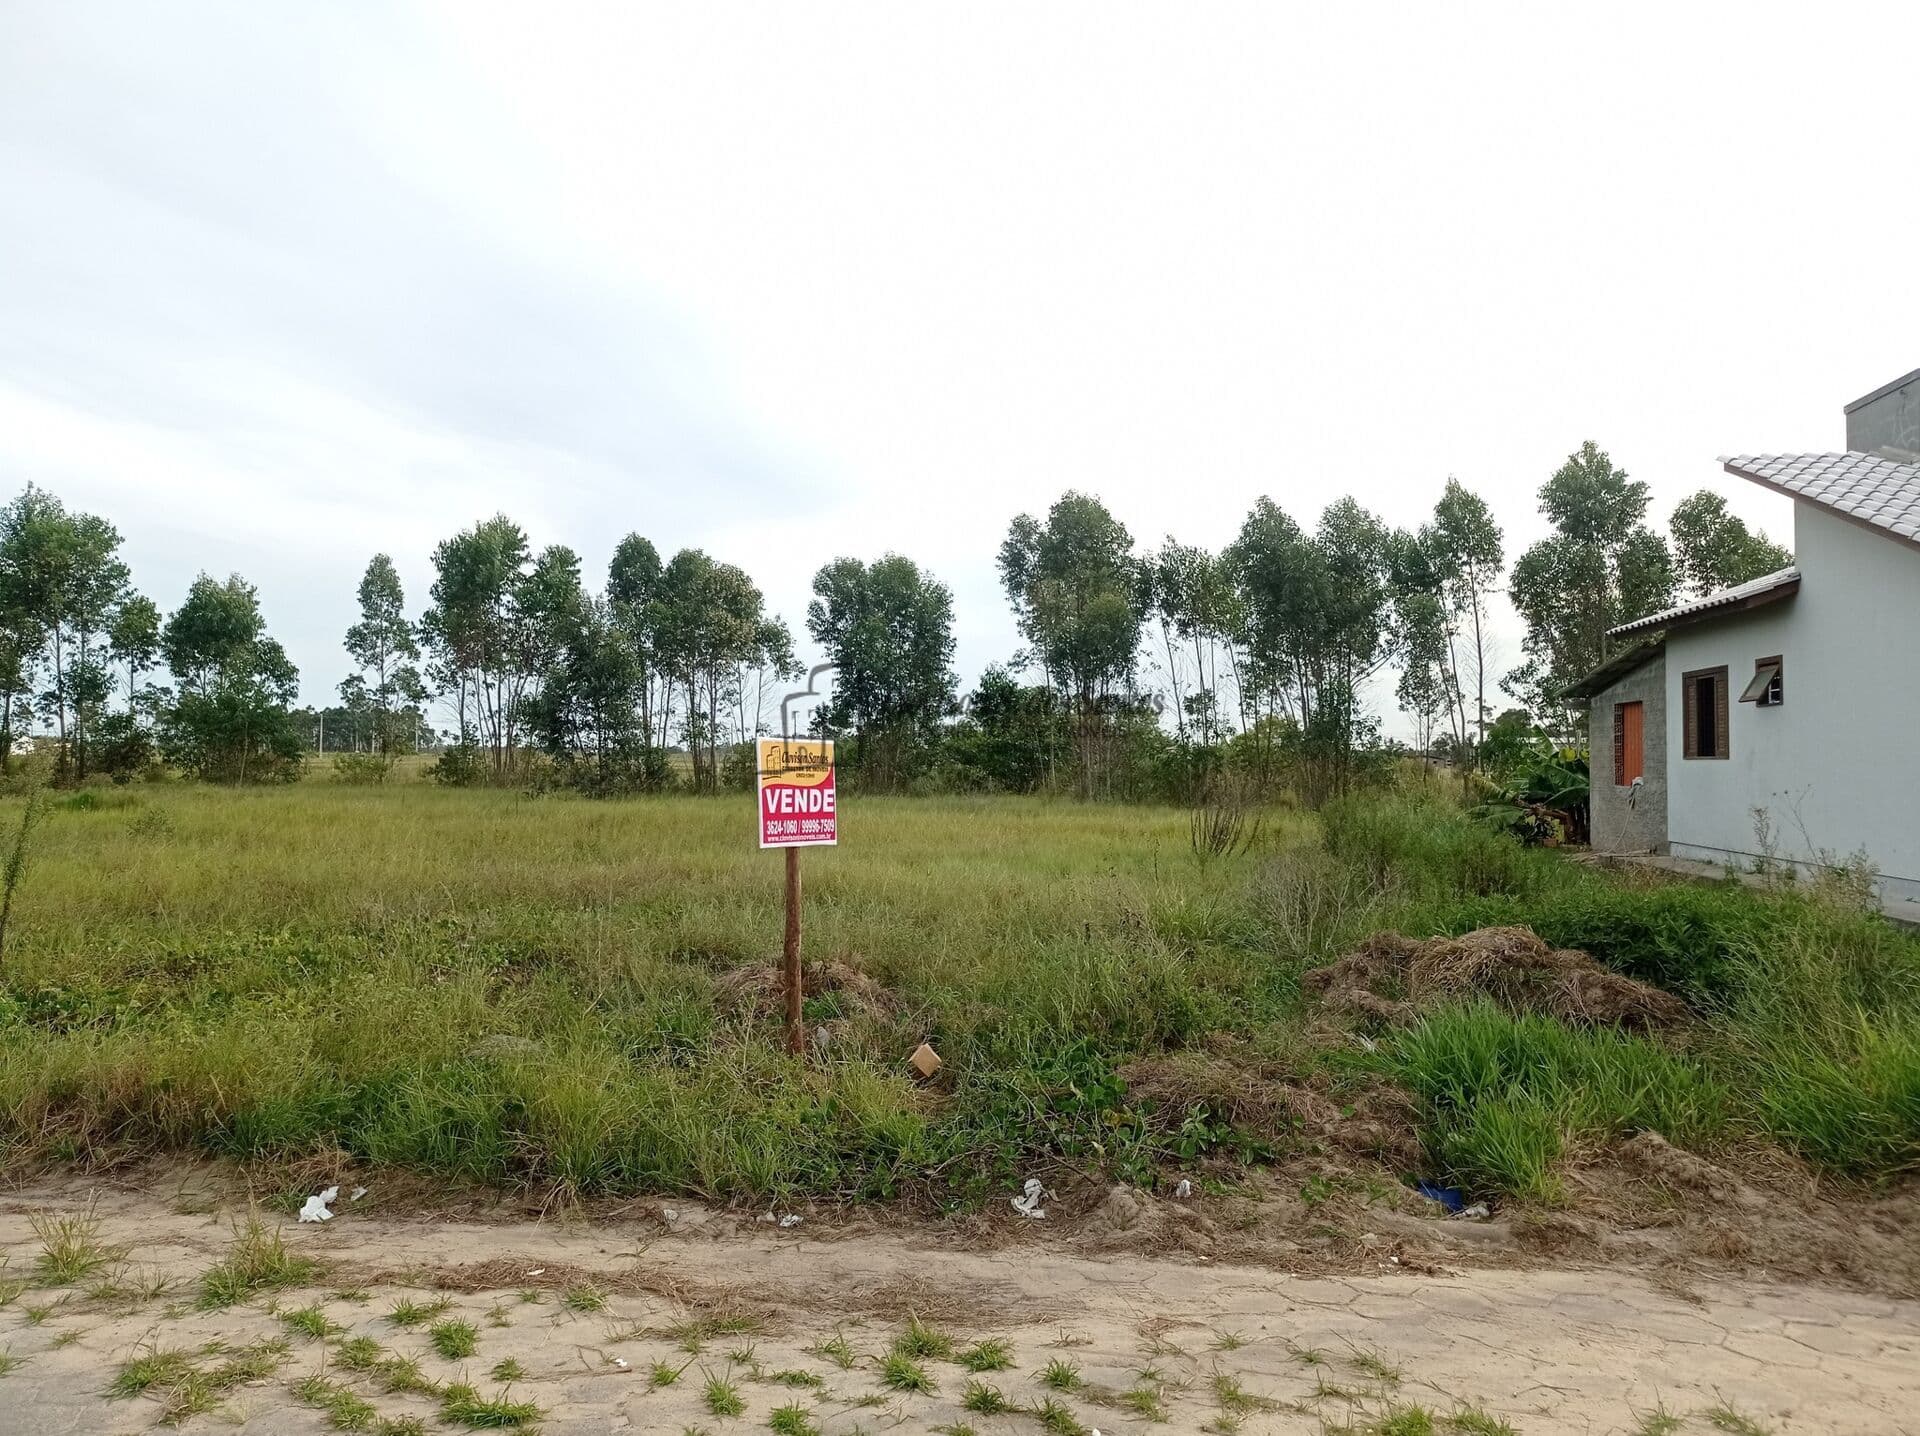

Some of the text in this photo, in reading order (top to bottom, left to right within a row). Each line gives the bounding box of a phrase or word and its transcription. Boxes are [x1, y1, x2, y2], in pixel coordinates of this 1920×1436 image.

[765, 789, 834, 813] VENDE
[767, 820, 797, 834] 3624-1060
[802, 819, 834, 833] 99996-7509
